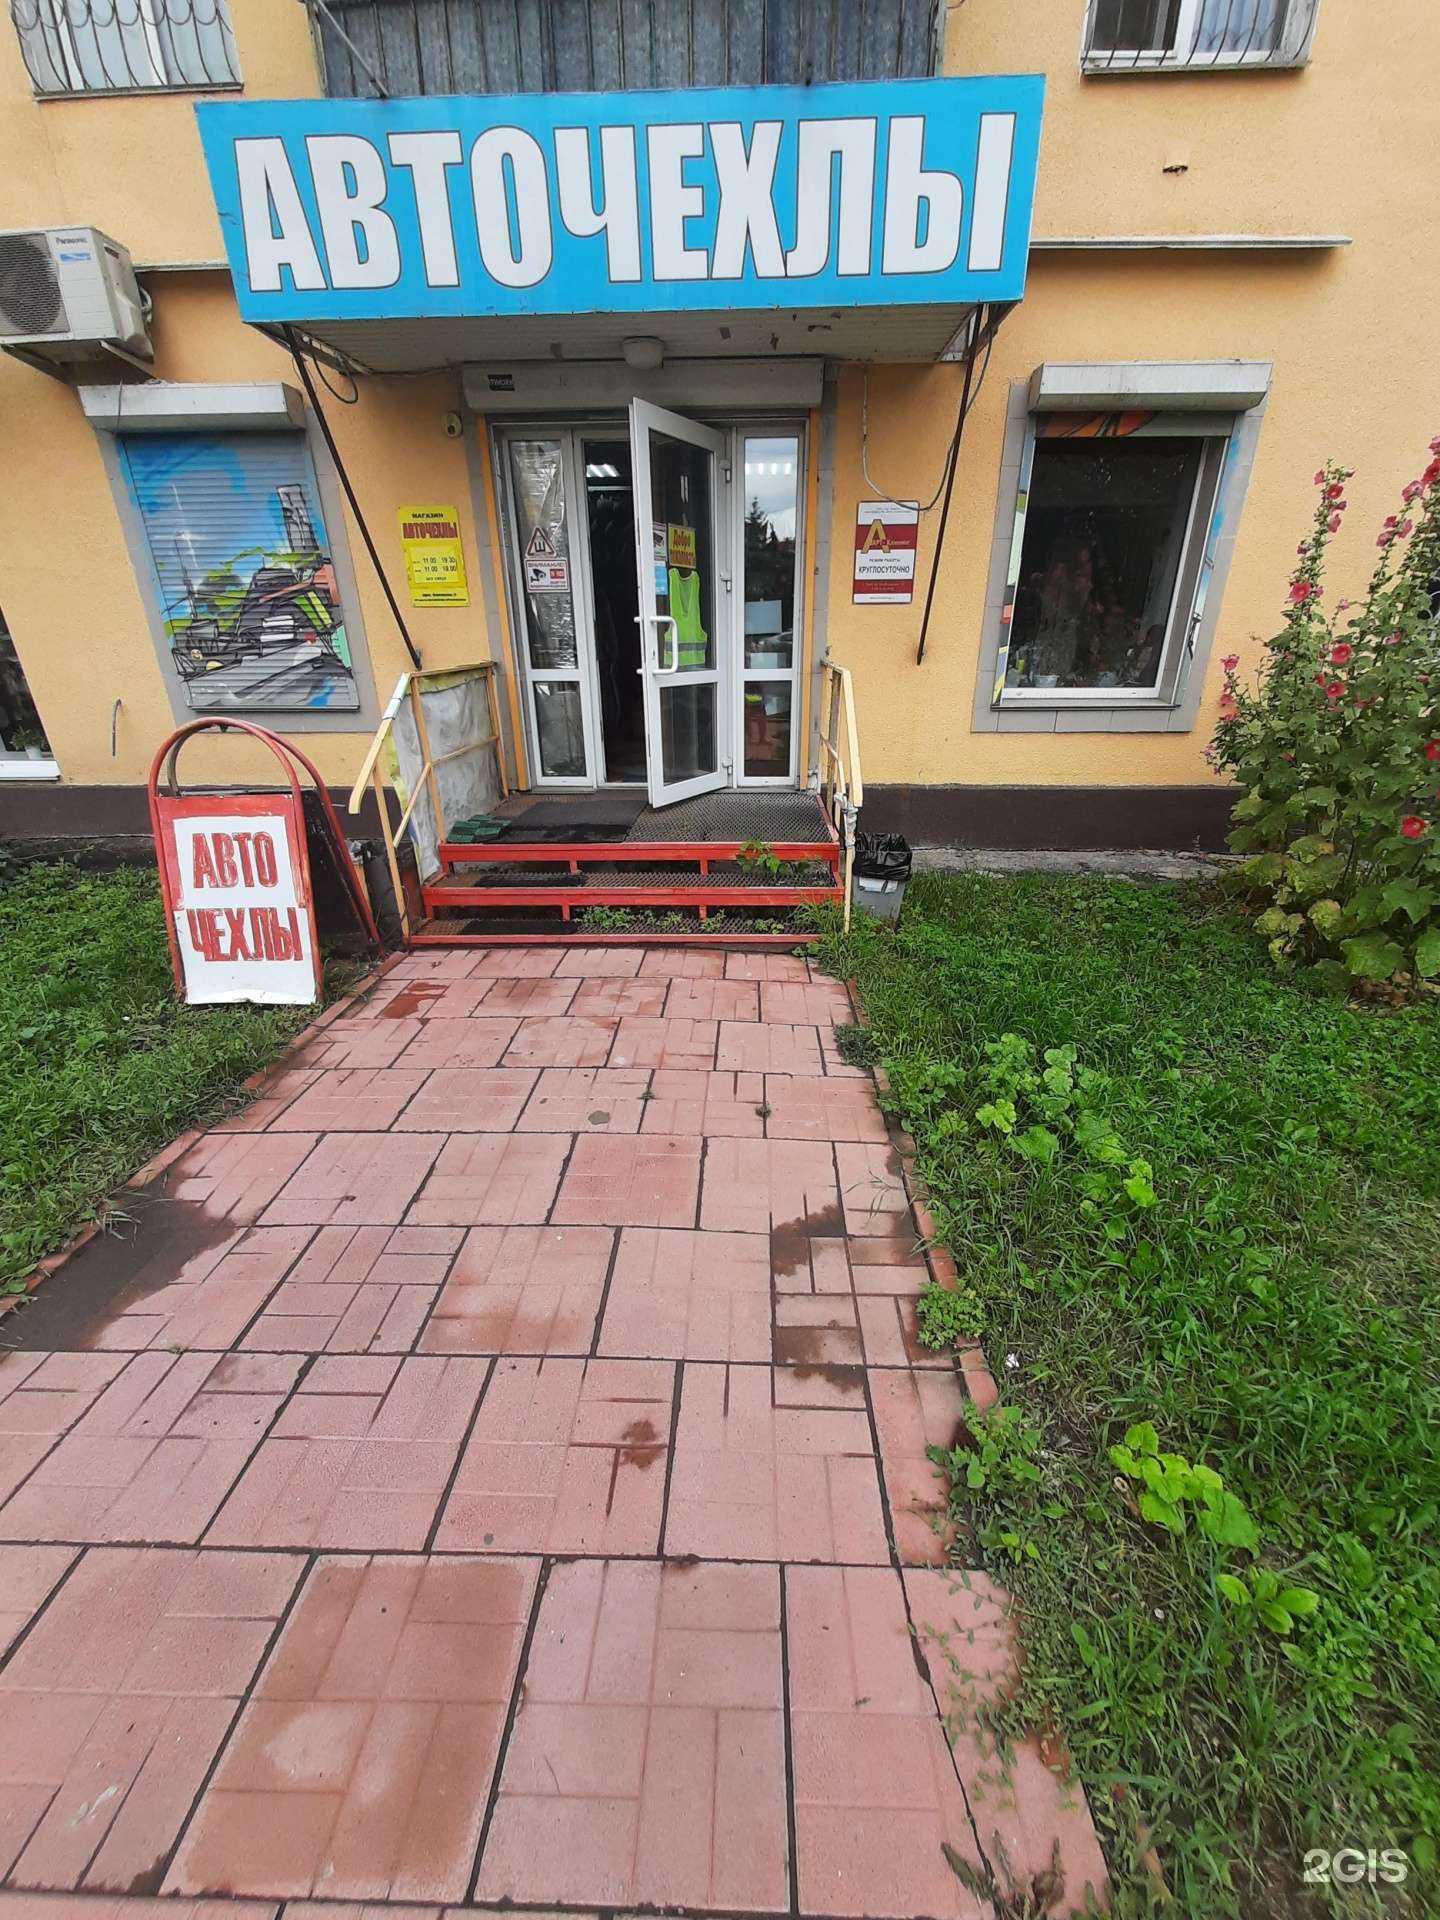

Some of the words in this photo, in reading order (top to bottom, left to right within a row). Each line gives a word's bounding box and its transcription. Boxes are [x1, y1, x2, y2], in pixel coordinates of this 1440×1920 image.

[233, 111, 1017, 293] АВТОЧЕХЛЫ
[859, 565, 910, 574] КРУГЛОСУТОЧНО
[192, 831, 279, 889] АВТО
[186, 906, 304, 962] ЧЕХЛЫ
